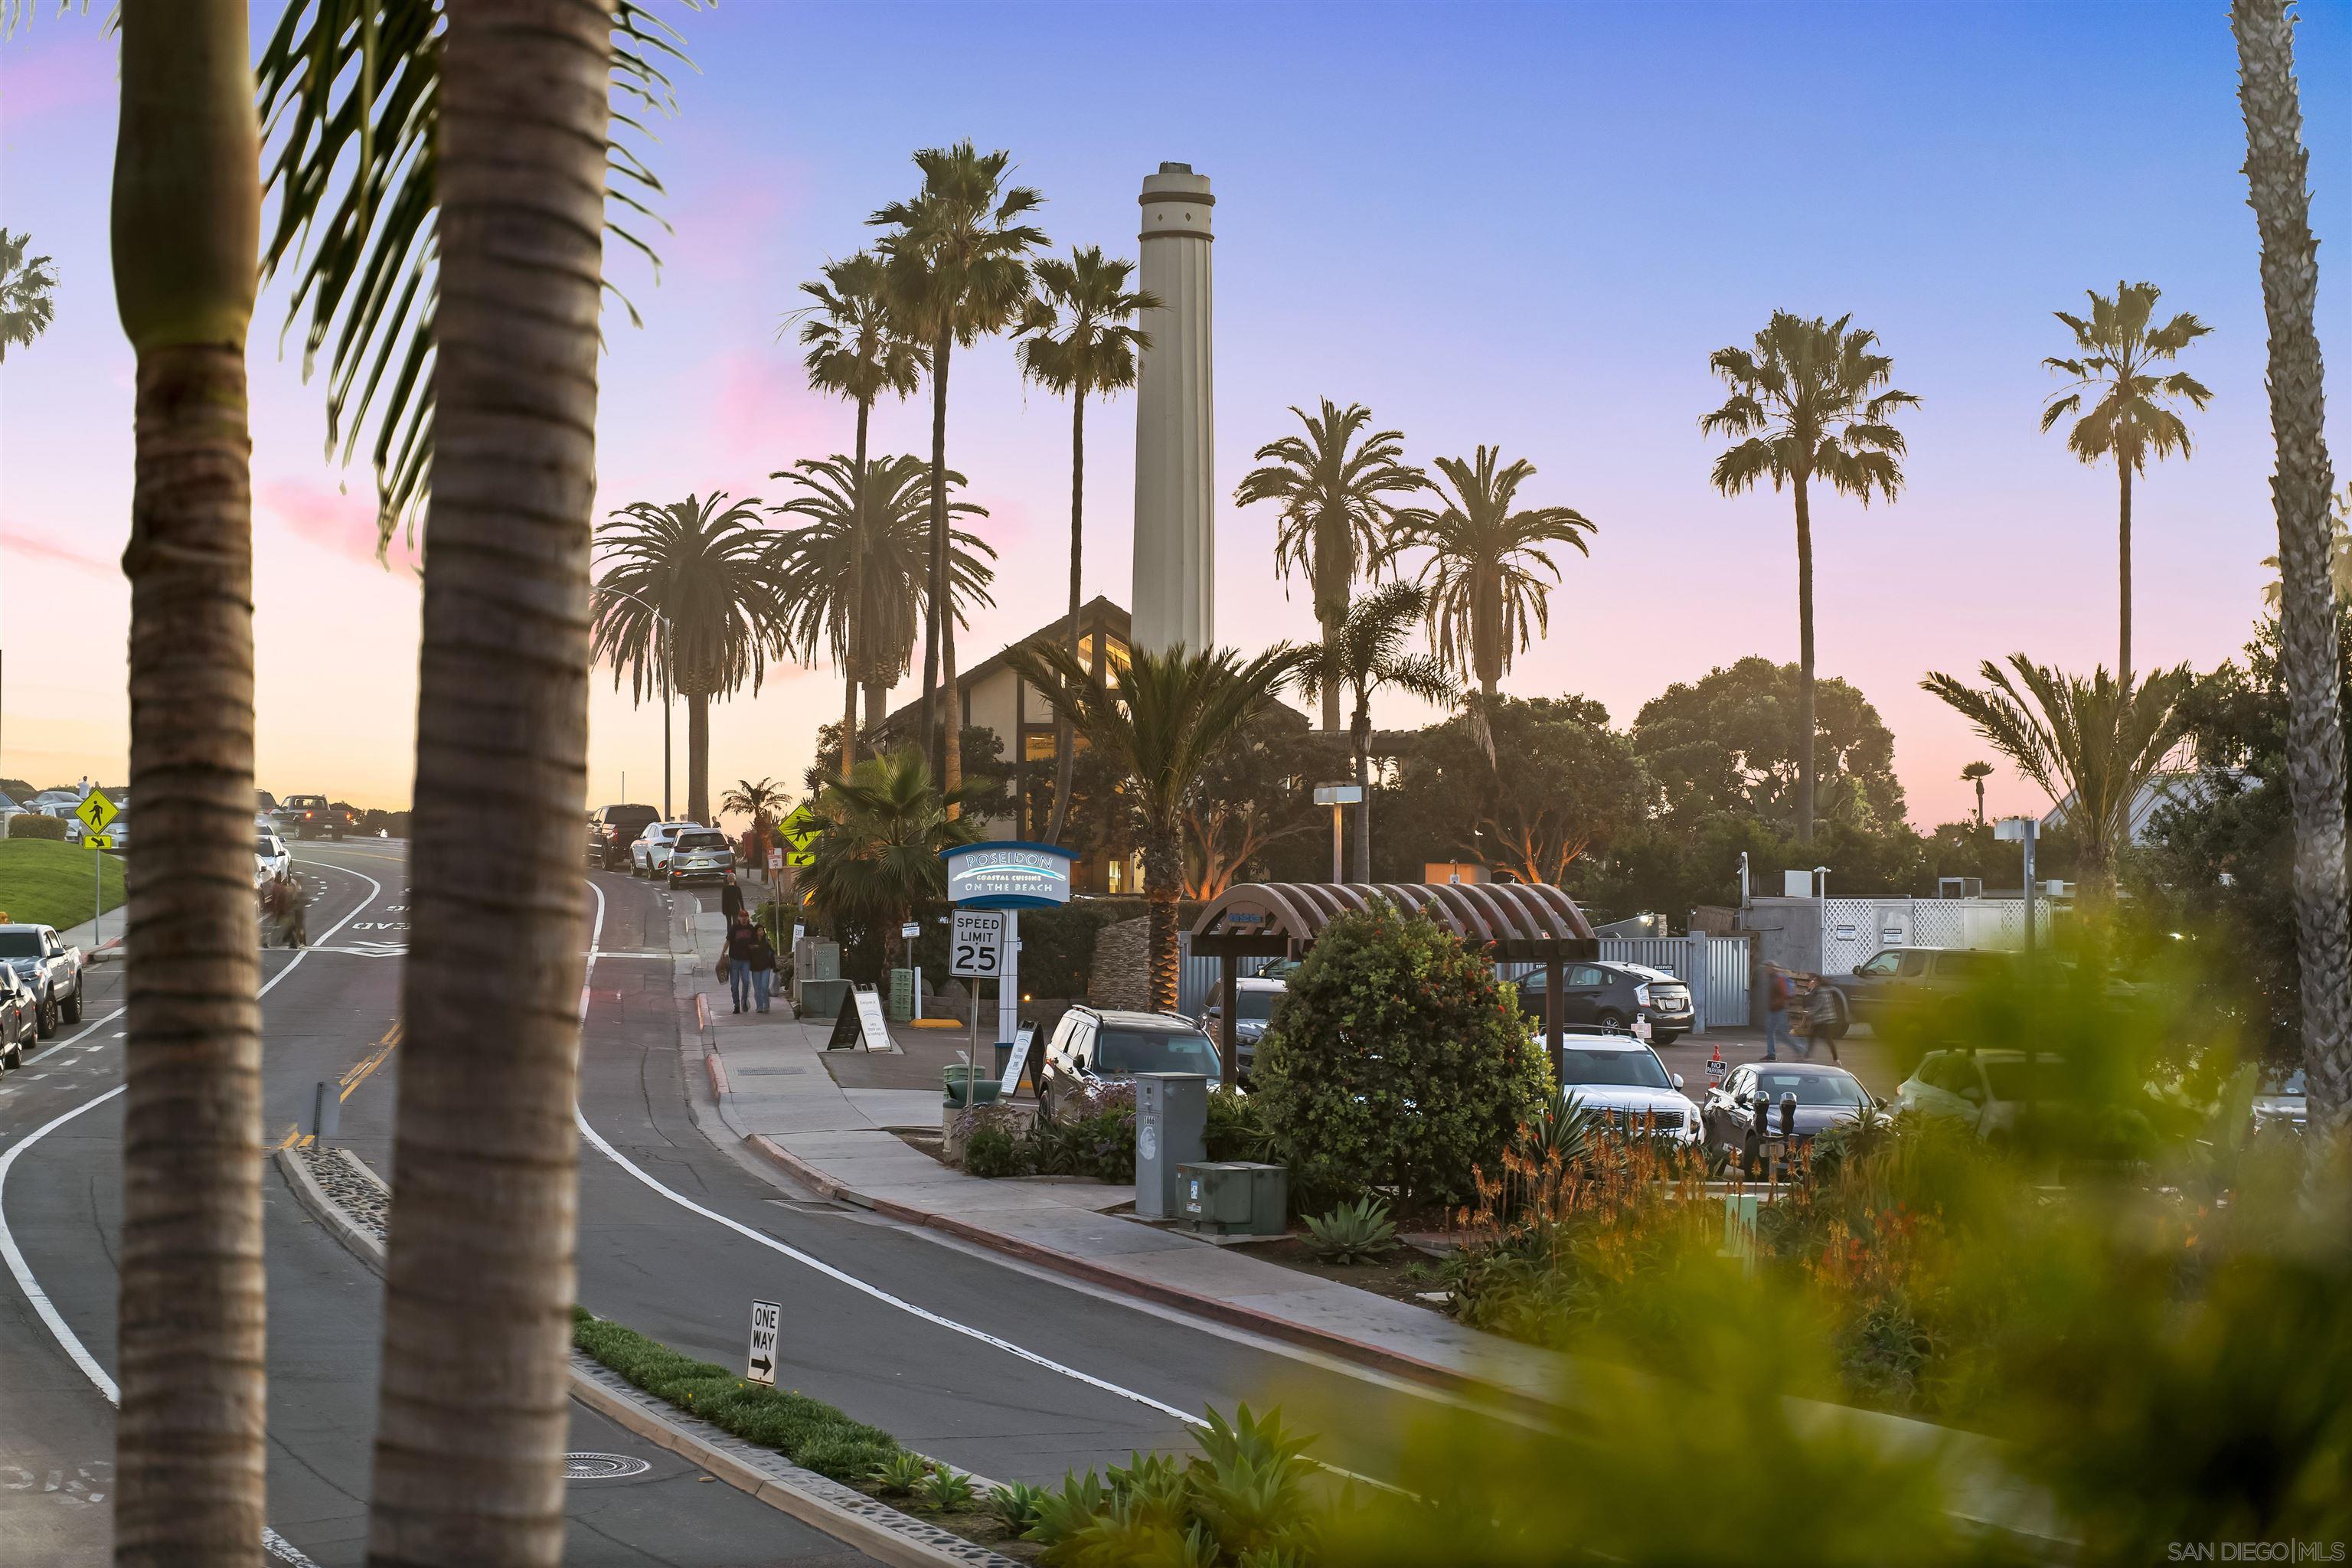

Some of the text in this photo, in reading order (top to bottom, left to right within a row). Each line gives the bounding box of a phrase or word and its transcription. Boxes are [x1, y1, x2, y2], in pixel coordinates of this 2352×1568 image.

[965, 852, 1054, 869] POSEIDON
[965, 883, 982, 891] ON
[1014, 884, 1053, 892] BEACH
[957, 918, 999, 929] SPEED
[961, 931, 994, 942] LIMIT
[956, 945, 996, 971] 25
[1707, 1067, 1724, 1075] PARKING
[755, 1308, 776, 1329] ONE
[753, 1329, 775, 1351] WAY
